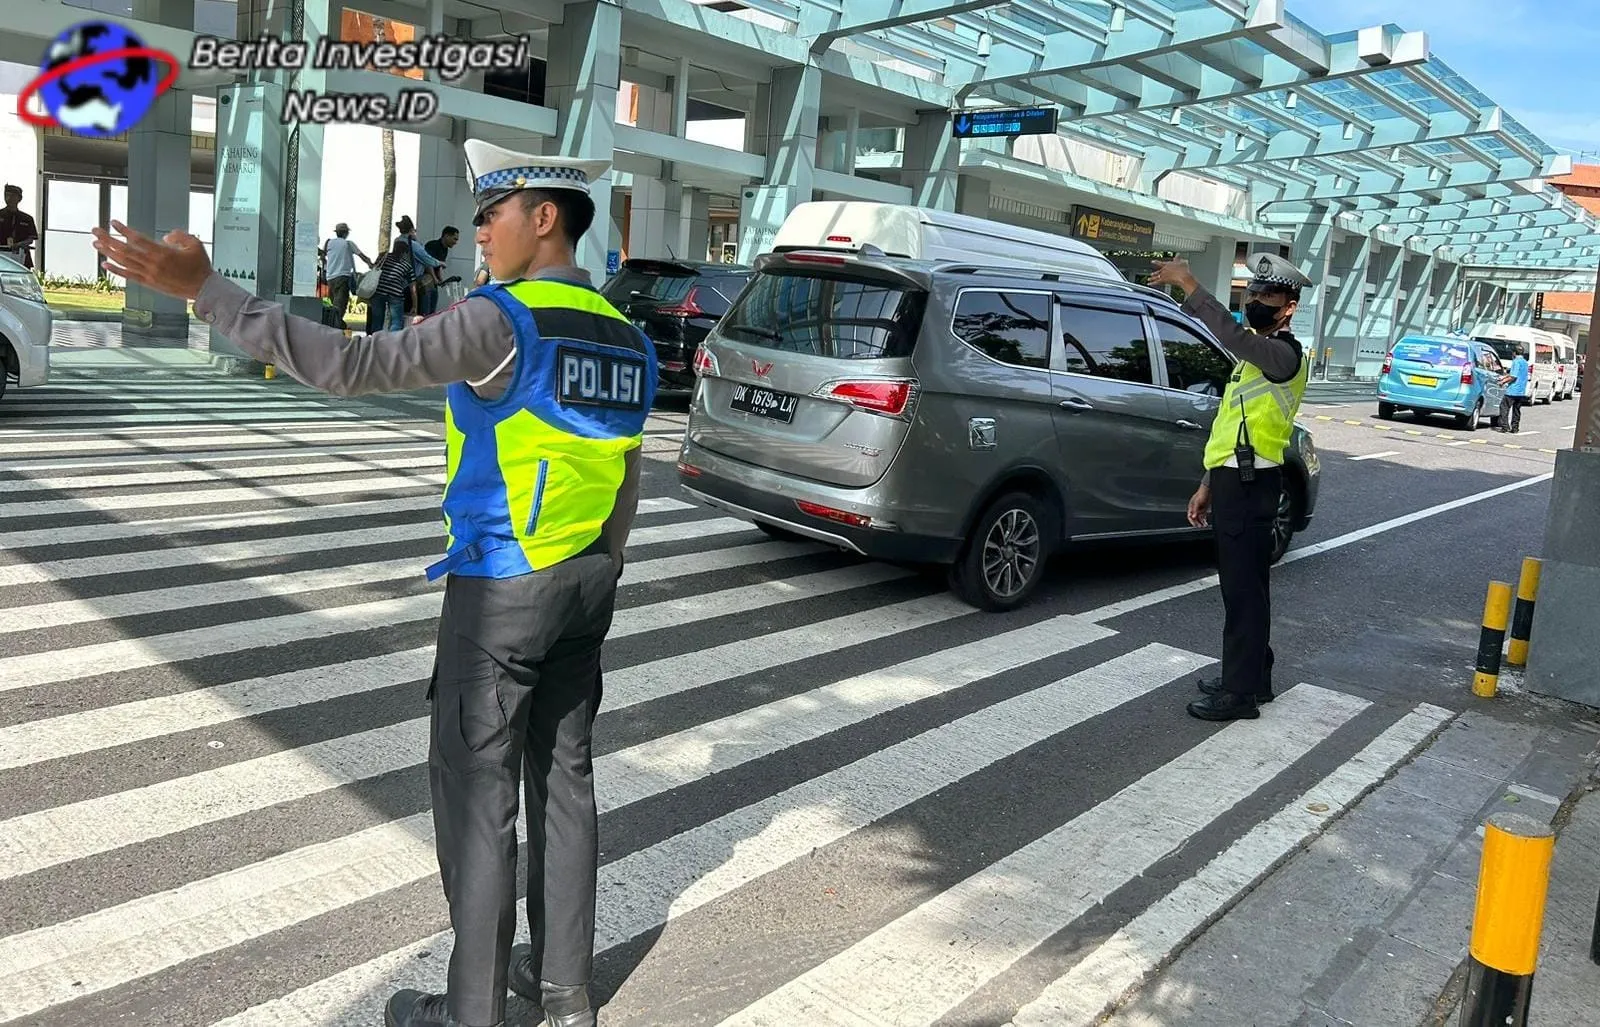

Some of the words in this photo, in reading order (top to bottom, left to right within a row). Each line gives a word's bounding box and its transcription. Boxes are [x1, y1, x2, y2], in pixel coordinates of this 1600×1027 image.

[221, 147, 258, 159] RAHAJENG
[744, 236, 775, 247] MEMARG
[563, 355, 641, 404] POLISI
[734, 385, 748, 402] DK
[751, 388, 774, 409] 1679
[780, 395, 795, 413] LX
